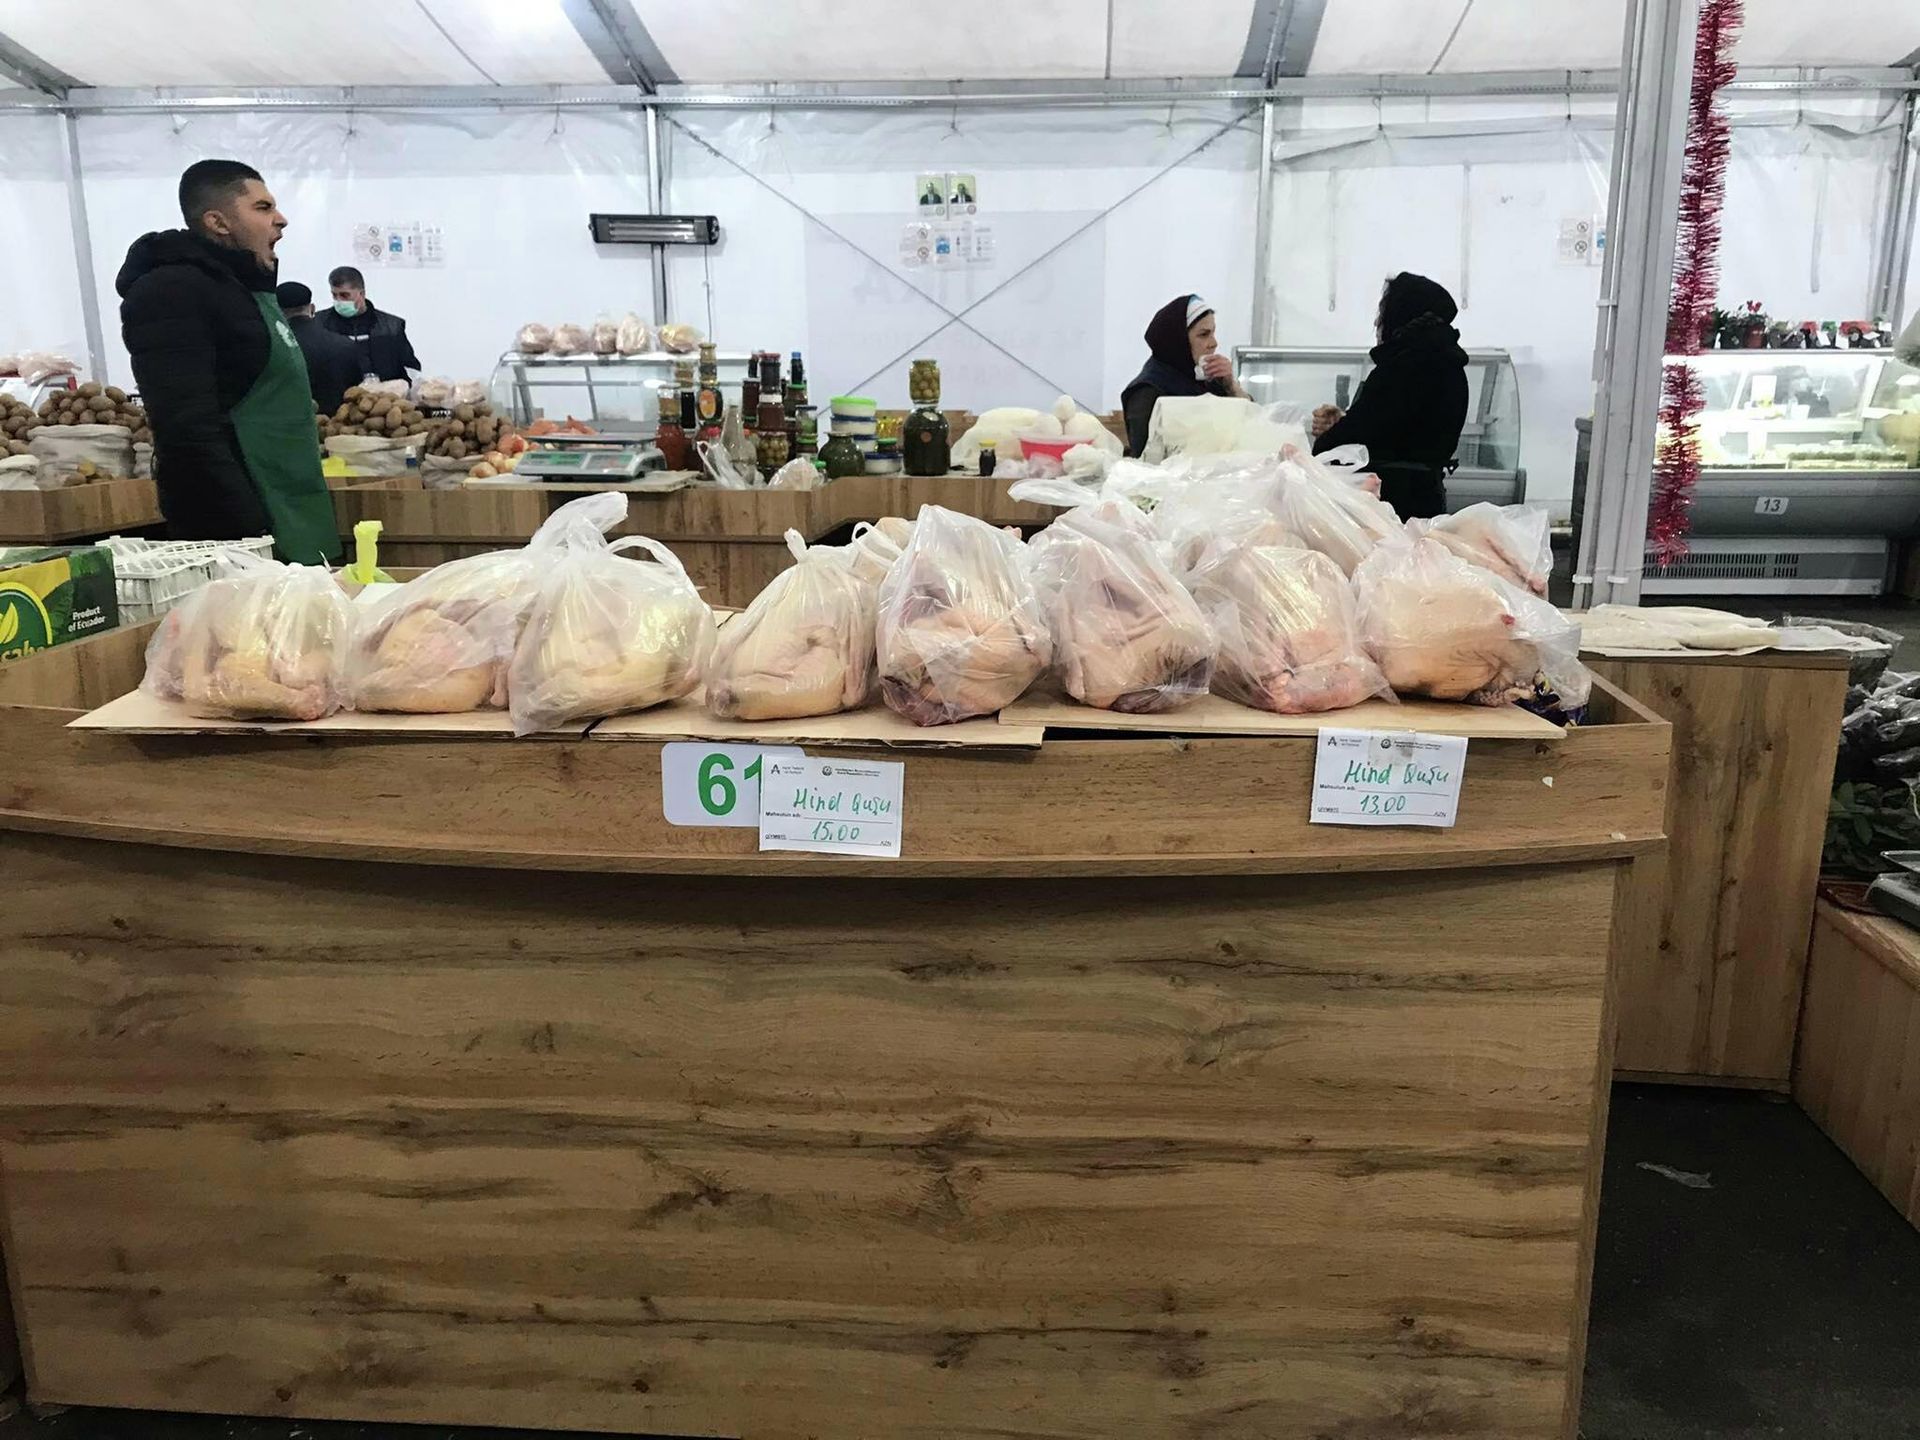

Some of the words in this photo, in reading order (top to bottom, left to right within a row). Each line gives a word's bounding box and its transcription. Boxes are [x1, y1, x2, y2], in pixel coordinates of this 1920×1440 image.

[1763, 499, 1781, 512] 13
[72, 606, 101, 620] Product
[67, 621, 77, 632] of
[77, 616, 106, 630] Ecuador
[1343, 759, 1393, 785] Hind
[793, 787, 842, 811] Hind
